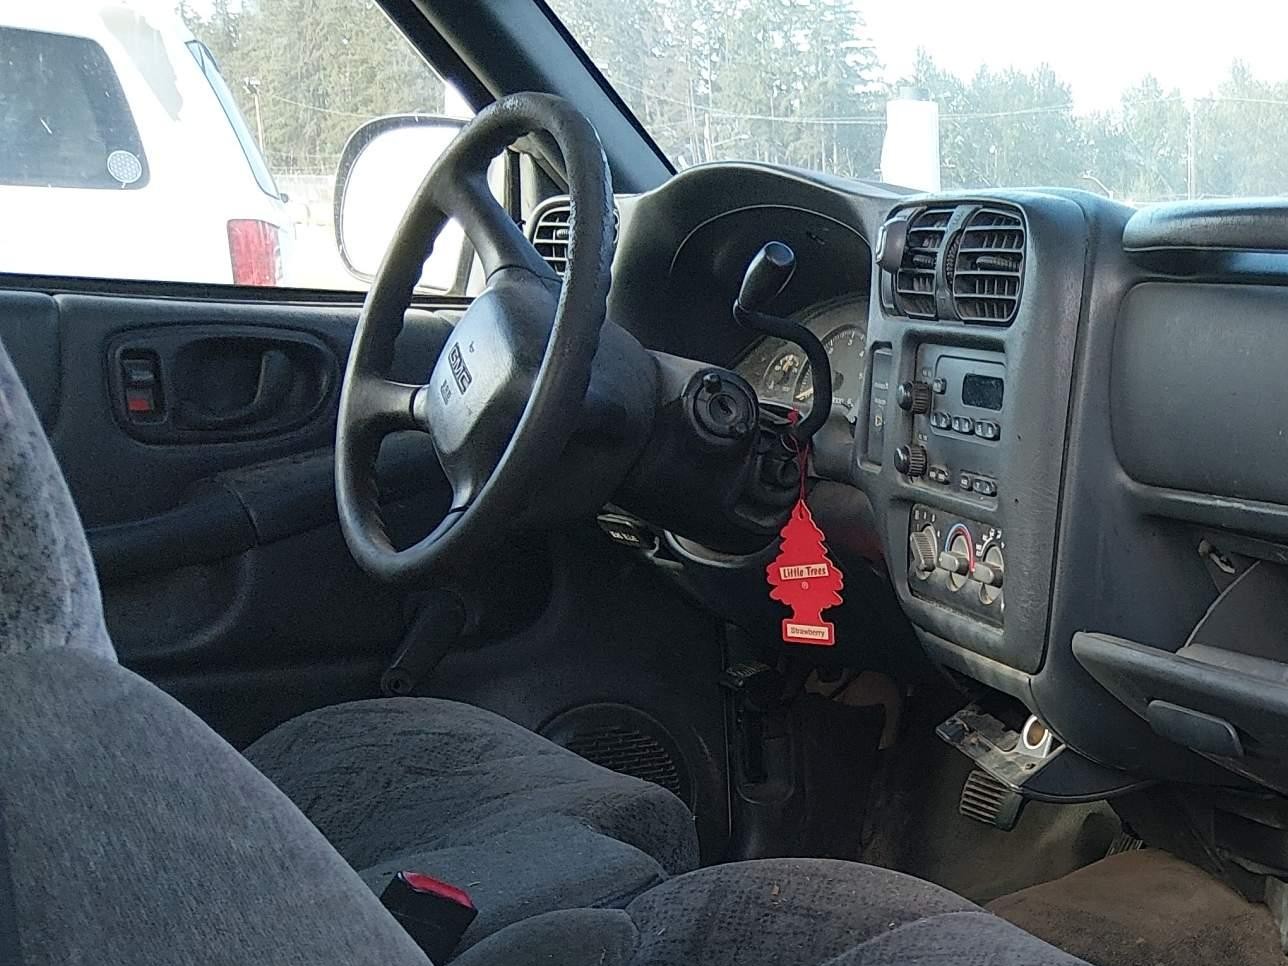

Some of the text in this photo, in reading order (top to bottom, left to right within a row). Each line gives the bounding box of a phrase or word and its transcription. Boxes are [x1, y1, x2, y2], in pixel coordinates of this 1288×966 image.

[448, 342, 473, 395] GMC
[783, 566, 827, 579] Little Trees
[790, 626, 825, 637] Strawberry
